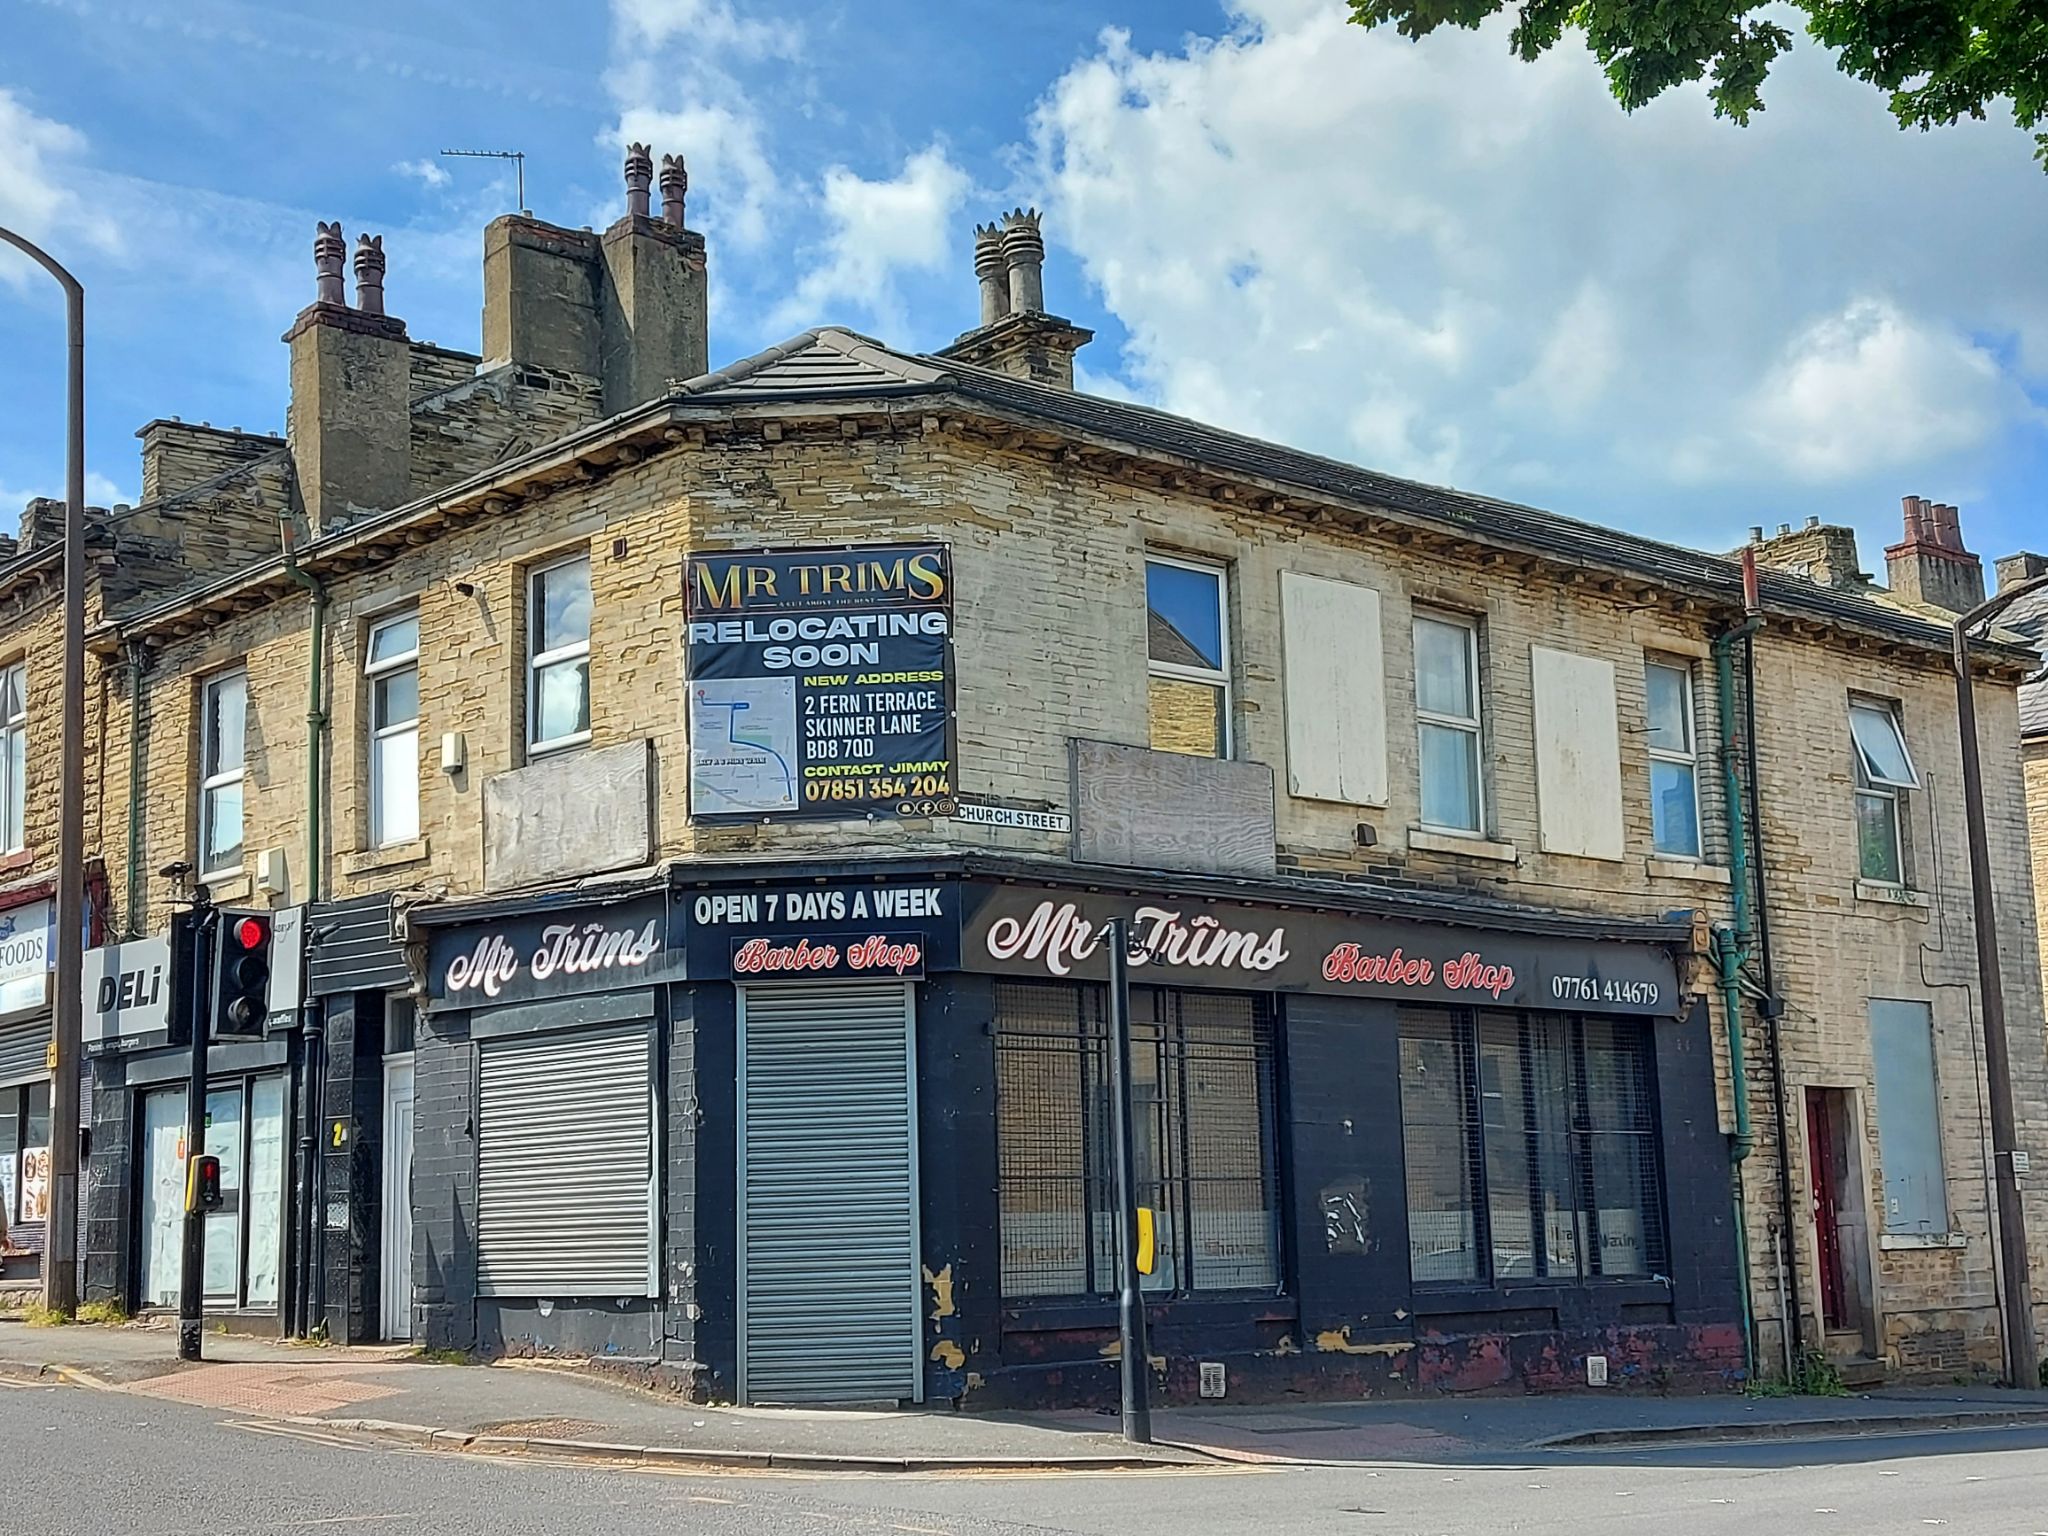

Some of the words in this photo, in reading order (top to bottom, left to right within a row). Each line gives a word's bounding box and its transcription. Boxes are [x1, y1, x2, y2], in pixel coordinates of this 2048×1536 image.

[695, 562, 778, 610] MR
[788, 553, 945, 600] TRIMS
[689, 612, 948, 645] RELOCATING
[763, 642, 879, 669] SOON
[803, 674, 849, 687] NEW
[855, 670, 944, 685] ADDRESS
[805, 696, 815, 715] 2
[820, 694, 862, 714] FERN
[865, 691, 937, 712] TERRACE
[805, 716, 876, 737] SKINNER
[881, 714, 922, 734] LANE
[806, 740, 839, 760] BD8
[843, 738, 874, 759] 7QD
[804, 764, 885, 777] CONTACT
[889, 761, 949, 775] JIMMY
[805, 779, 865, 801] 07851
[869, 777, 907, 799] 354
[911, 775, 949, 797] 204
[958, 806, 1012, 825] CHURCH
[1016, 814, 1063, 830] STREET
[695, 895, 758, 924] OPEN
[765, 895, 778, 921] 7
[786, 891, 845, 922] DAYS
[852, 891, 868, 919] A
[873, 888, 942, 918] WEEK
[987, 901, 1106, 976] Mr
[447, 935, 518, 997] Mr
[734, 938, 839, 973] Barber
[847, 936, 921, 975] Shop
[1323, 943, 1435, 985] Barber
[1443, 952, 1515, 1000] Shop
[1552, 975, 1599, 1001] 07761
[1603, 978, 1660, 1005] 414679
